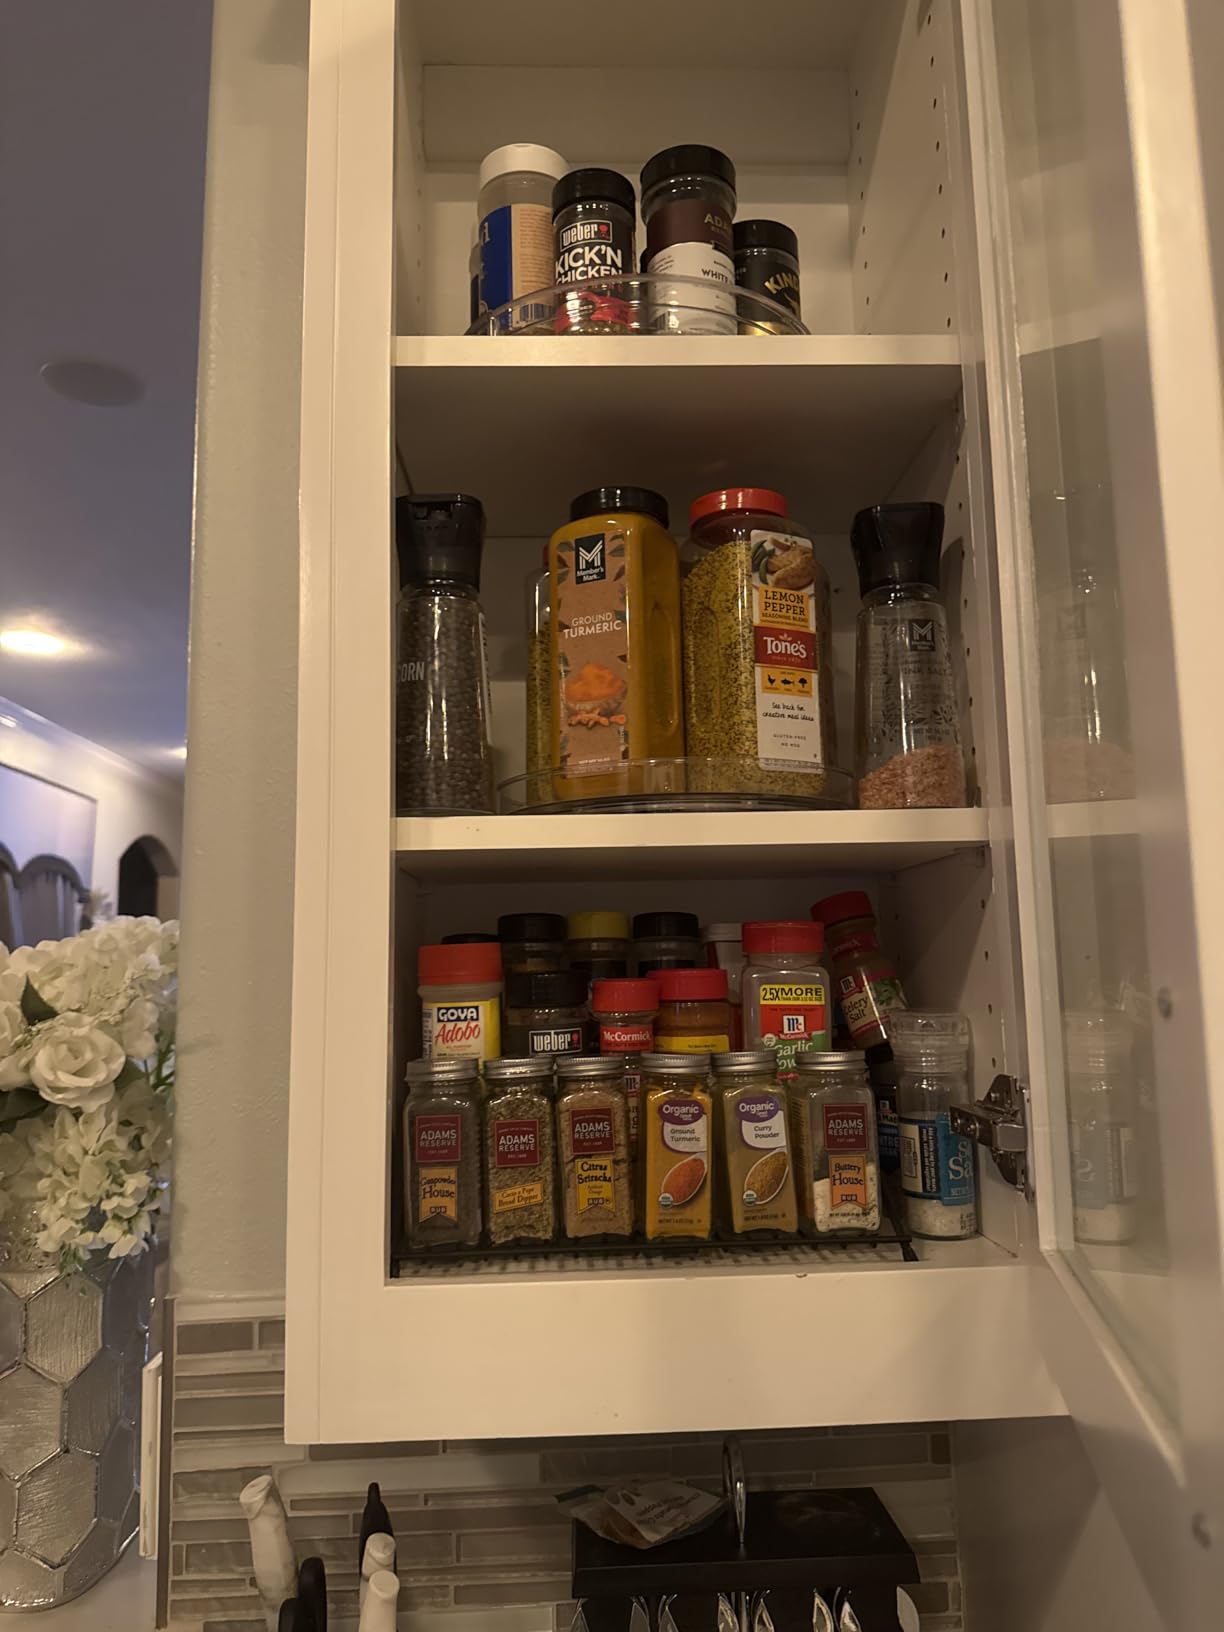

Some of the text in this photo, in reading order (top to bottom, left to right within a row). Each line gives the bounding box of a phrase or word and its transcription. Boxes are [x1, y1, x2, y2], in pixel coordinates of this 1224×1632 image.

[563, 223, 598, 246] weber
[555, 245, 622, 278] KICK'N
[577, 567, 605, 577] Member's
[764, 590, 804, 604] LEMON
[764, 602, 805, 616] PEPPER
[572, 612, 612, 626] GROUND
[563, 620, 622, 639] TURMERIC
[763, 636, 807, 659] Tone's
[780, 987, 822, 997] MORE
[438, 1007, 477, 1021] GOYA
[434, 1021, 480, 1046] Adobo
[603, 1031, 652, 1042] McCormick
[533, 1030, 571, 1052] weber
[662, 1104, 699, 1117] Organic
[739, 1102, 774, 1114] Organic
[575, 1121, 611, 1132] ADAMS
[828, 1119, 863, 1129] ADAMS
[420, 1129, 457, 1140] ADAMS
[574, 1131, 611, 1140] RESERVE
[755, 1131, 779, 1139] Powder
[828, 1128, 864, 1136] RESERVE
[419, 1138, 457, 1148] RESERVE
[499, 1134, 535, 1145] ADAMS
[498, 1143, 535, 1152] RESERVE
[581, 1161, 608, 1172] Citrus
[577, 1172, 612, 1184] Sriracha
[832, 1173, 864, 1186] House
[422, 1185, 456, 1199] House
